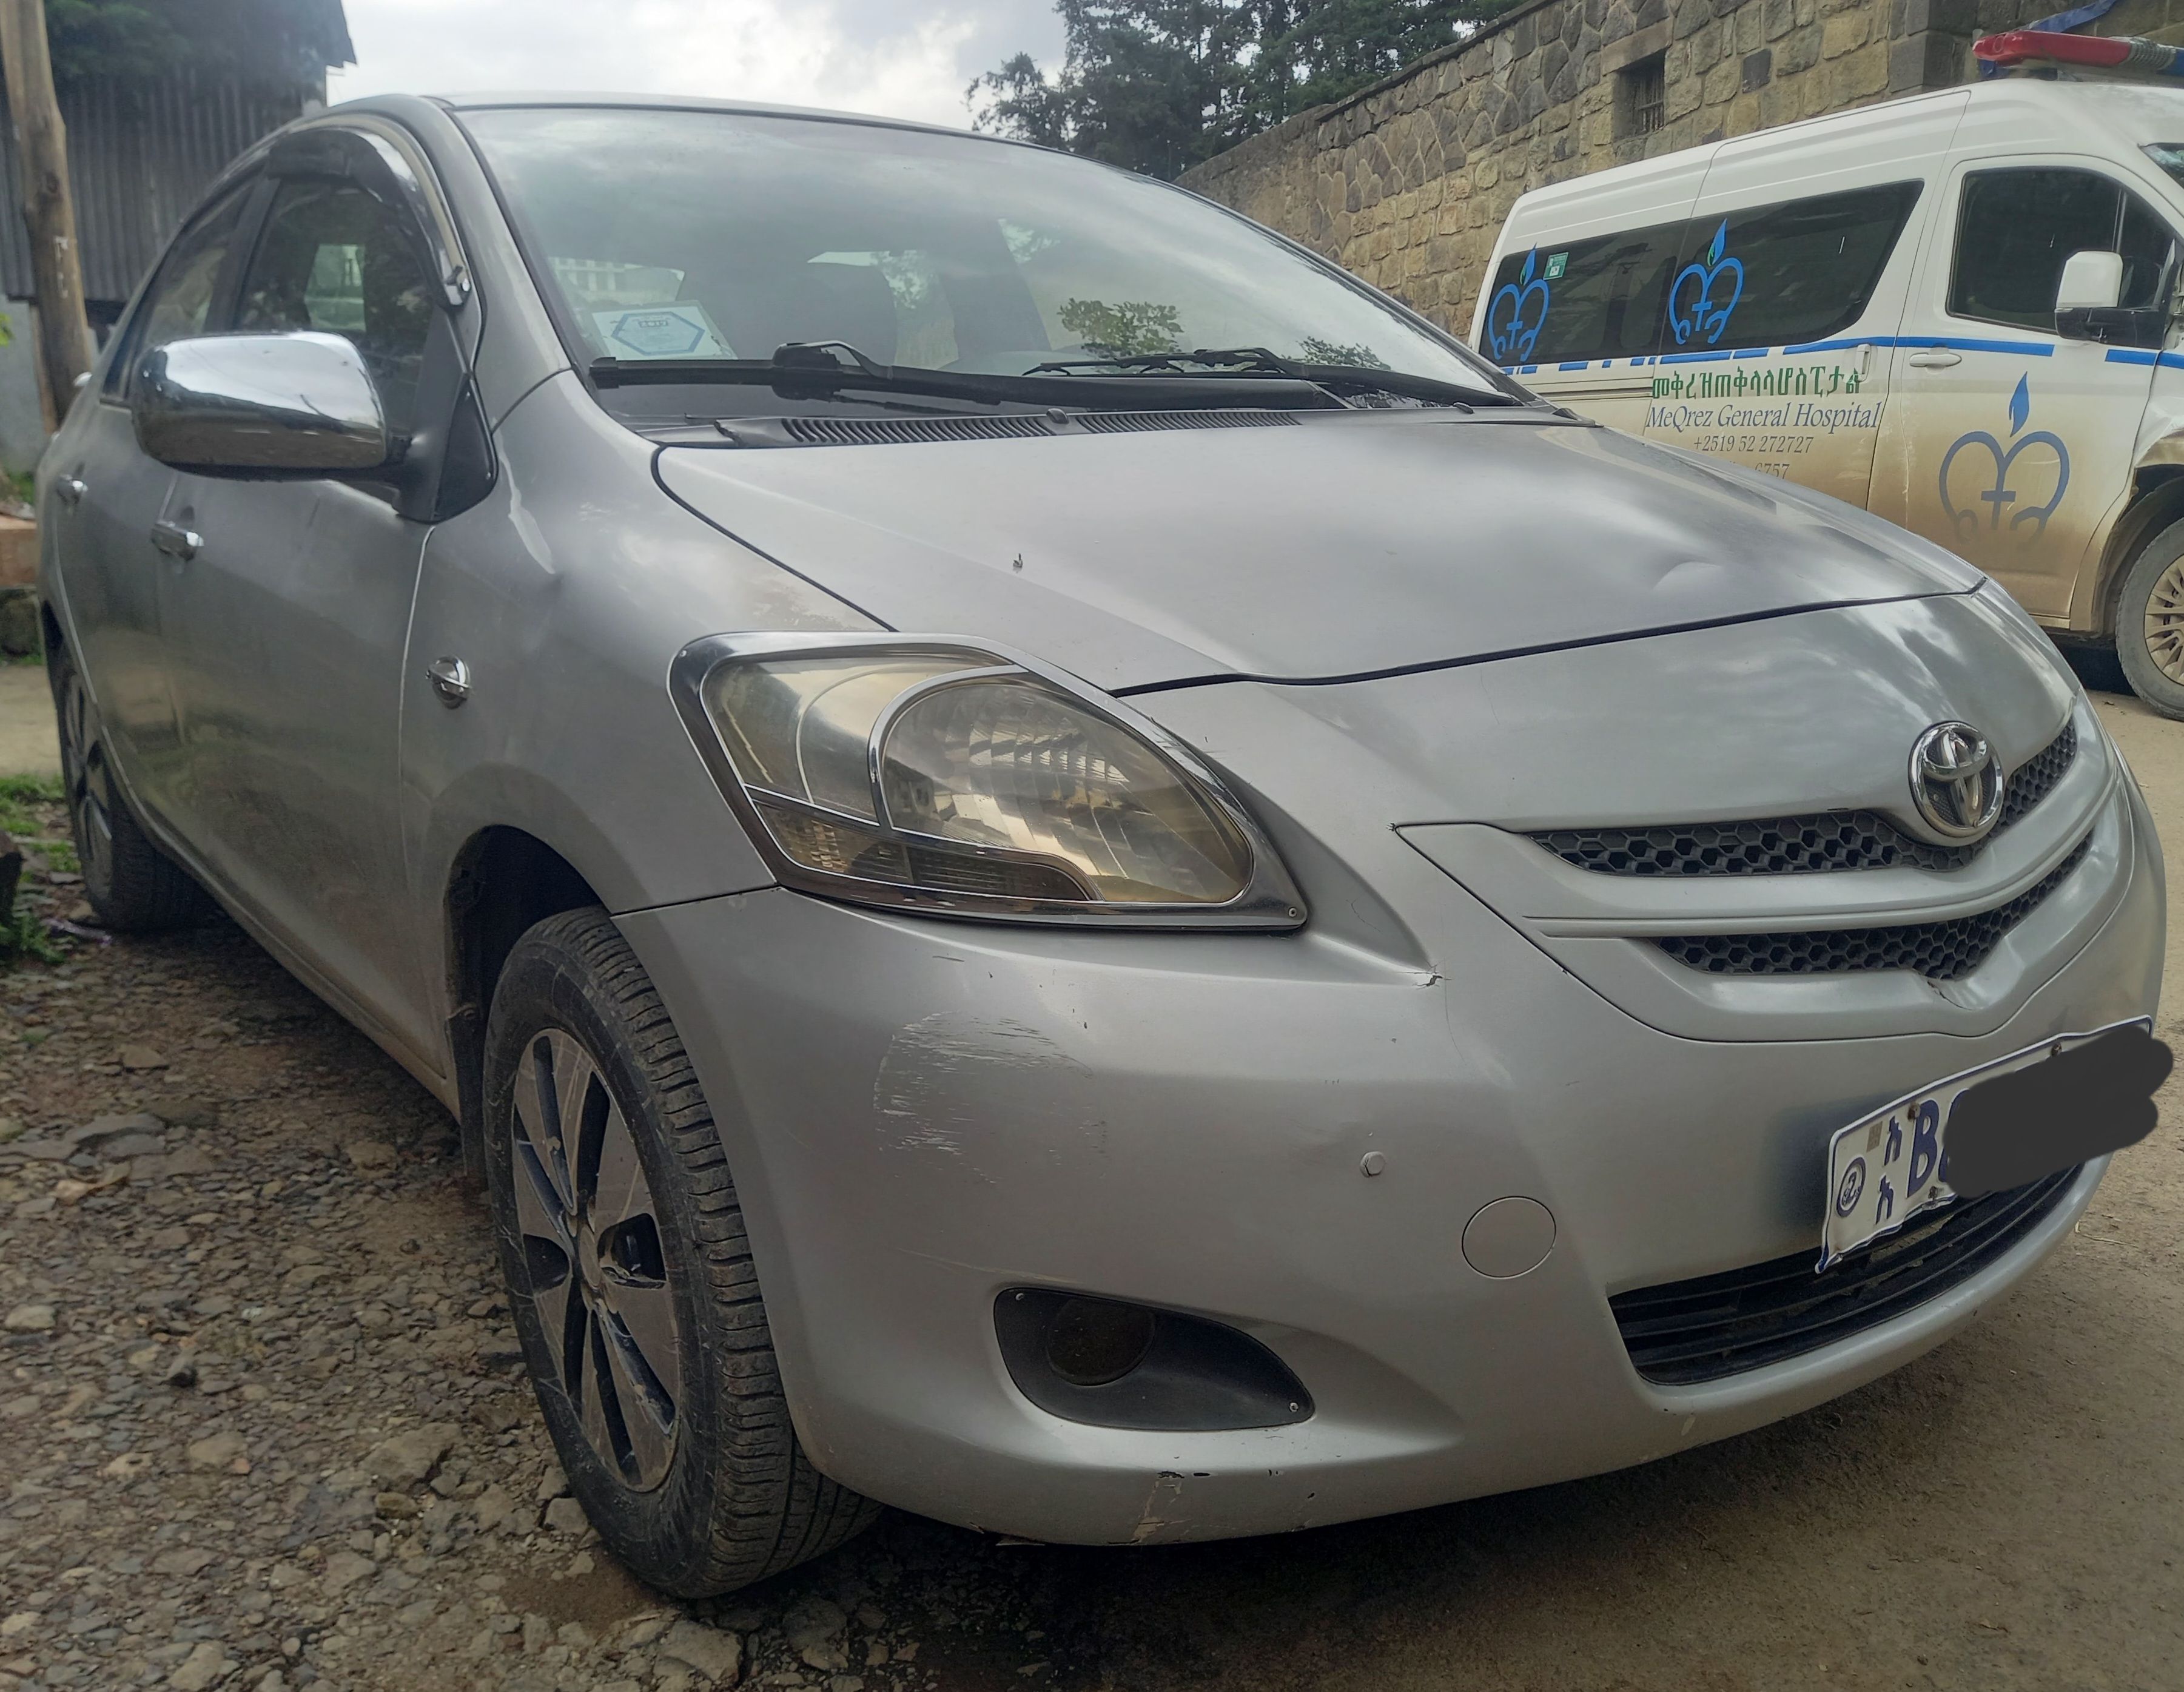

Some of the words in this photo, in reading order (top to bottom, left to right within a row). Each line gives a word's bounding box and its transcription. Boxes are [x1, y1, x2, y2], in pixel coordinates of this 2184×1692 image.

[1645, 405, 1713, 433] MeQrez
[1718, 402, 1792, 428] General
[1793, 401, 1883, 434] Hospital
[1694, 436, 1735, 453] +2519
[1738, 436, 1755, 453] 52
[1758, 436, 1815, 454] 272727
